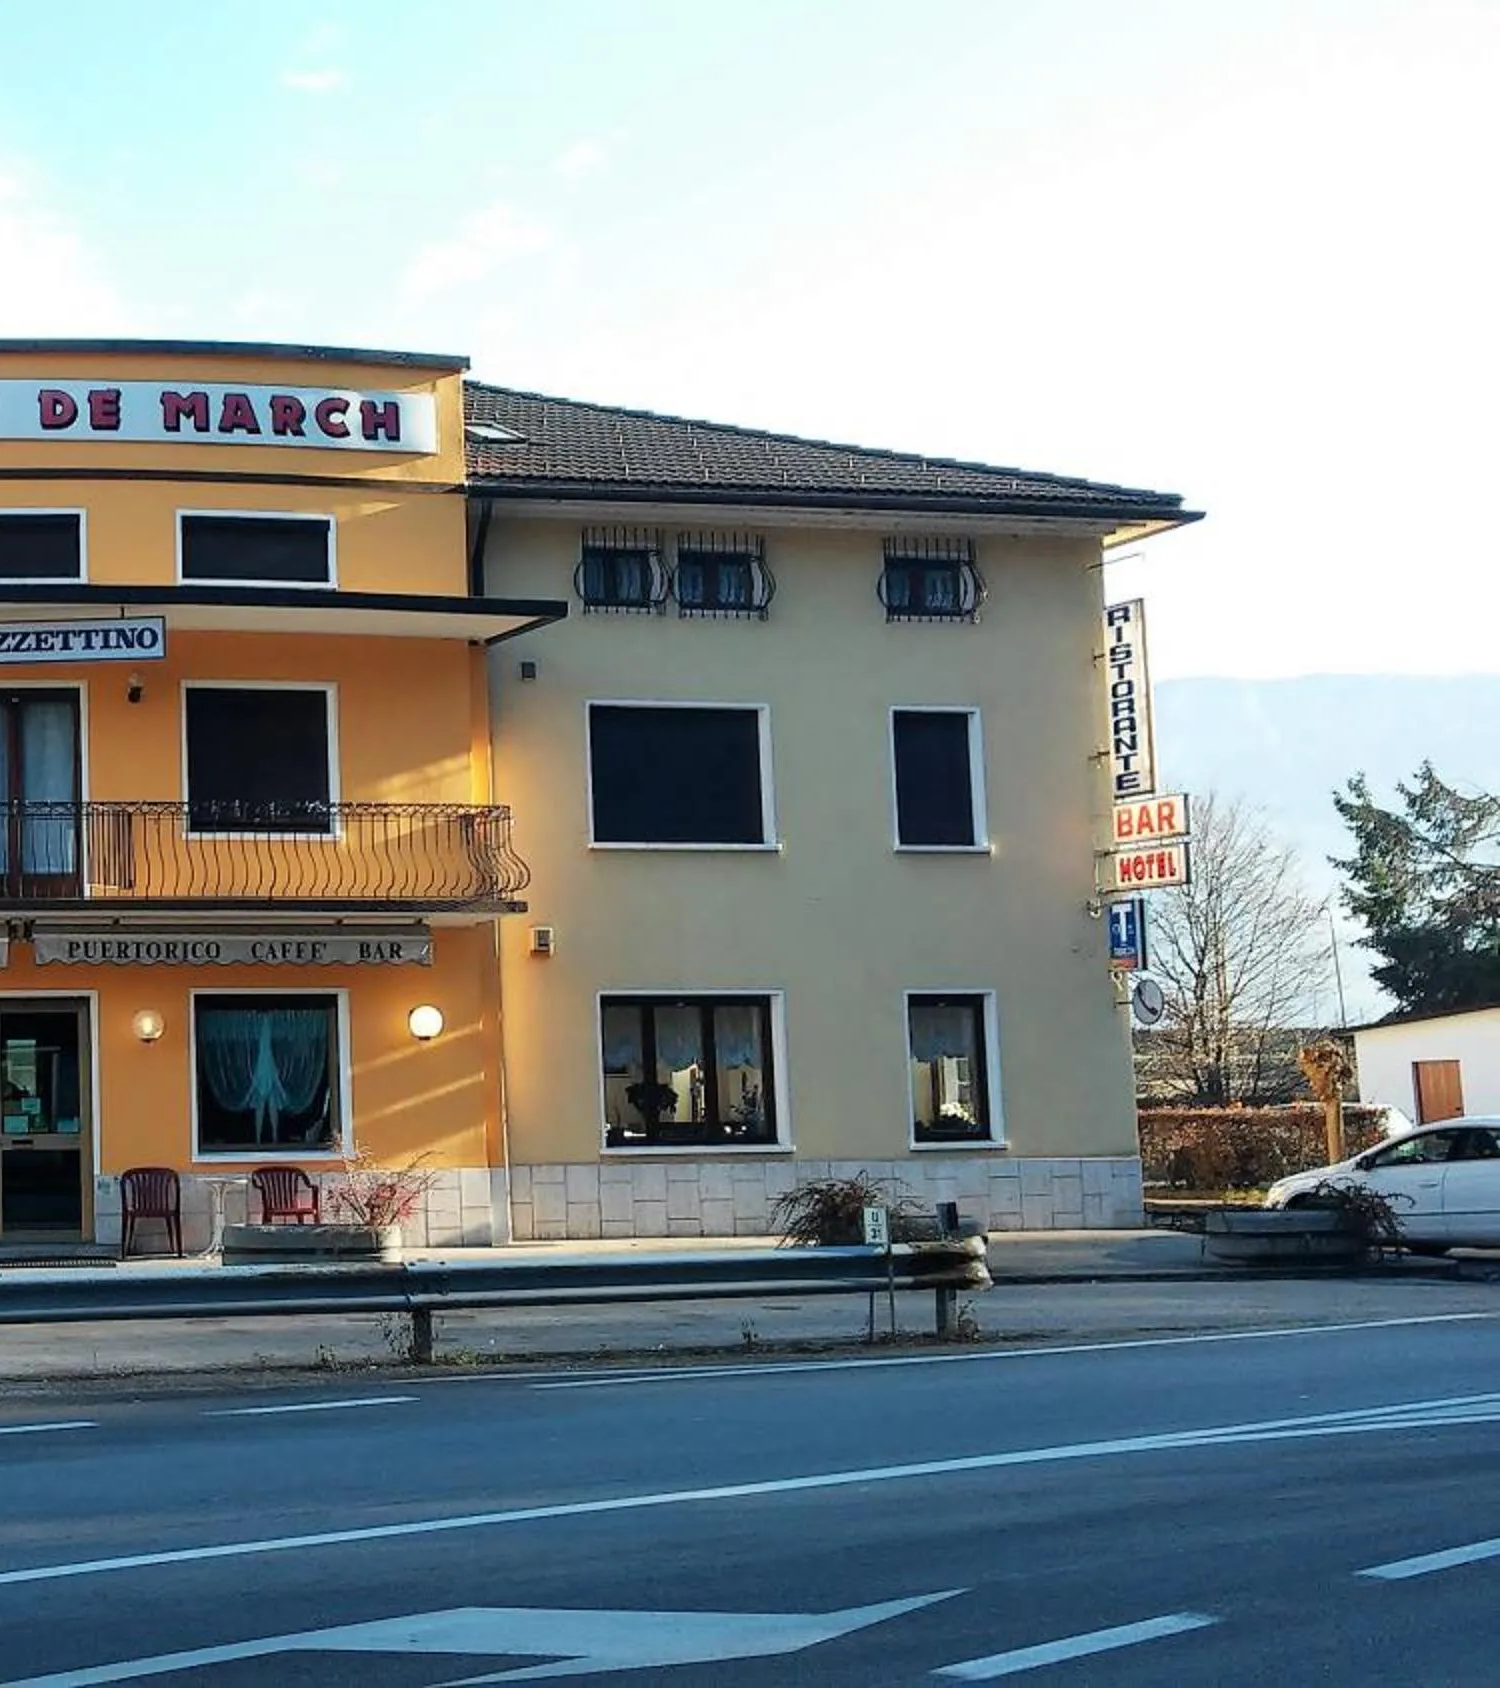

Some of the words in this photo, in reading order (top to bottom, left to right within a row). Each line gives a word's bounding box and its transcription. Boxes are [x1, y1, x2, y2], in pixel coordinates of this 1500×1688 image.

[37, 387, 122, 431] DE
[158, 390, 401, 442] MARCH
[1107, 604, 1139, 791] RISTORANTE
[1117, 800, 1177, 838] BAR
[1119, 855, 1177, 884] HOTEL
[67, 940, 222, 960] PUERTORICO
[358, 941, 405, 960] BAR
